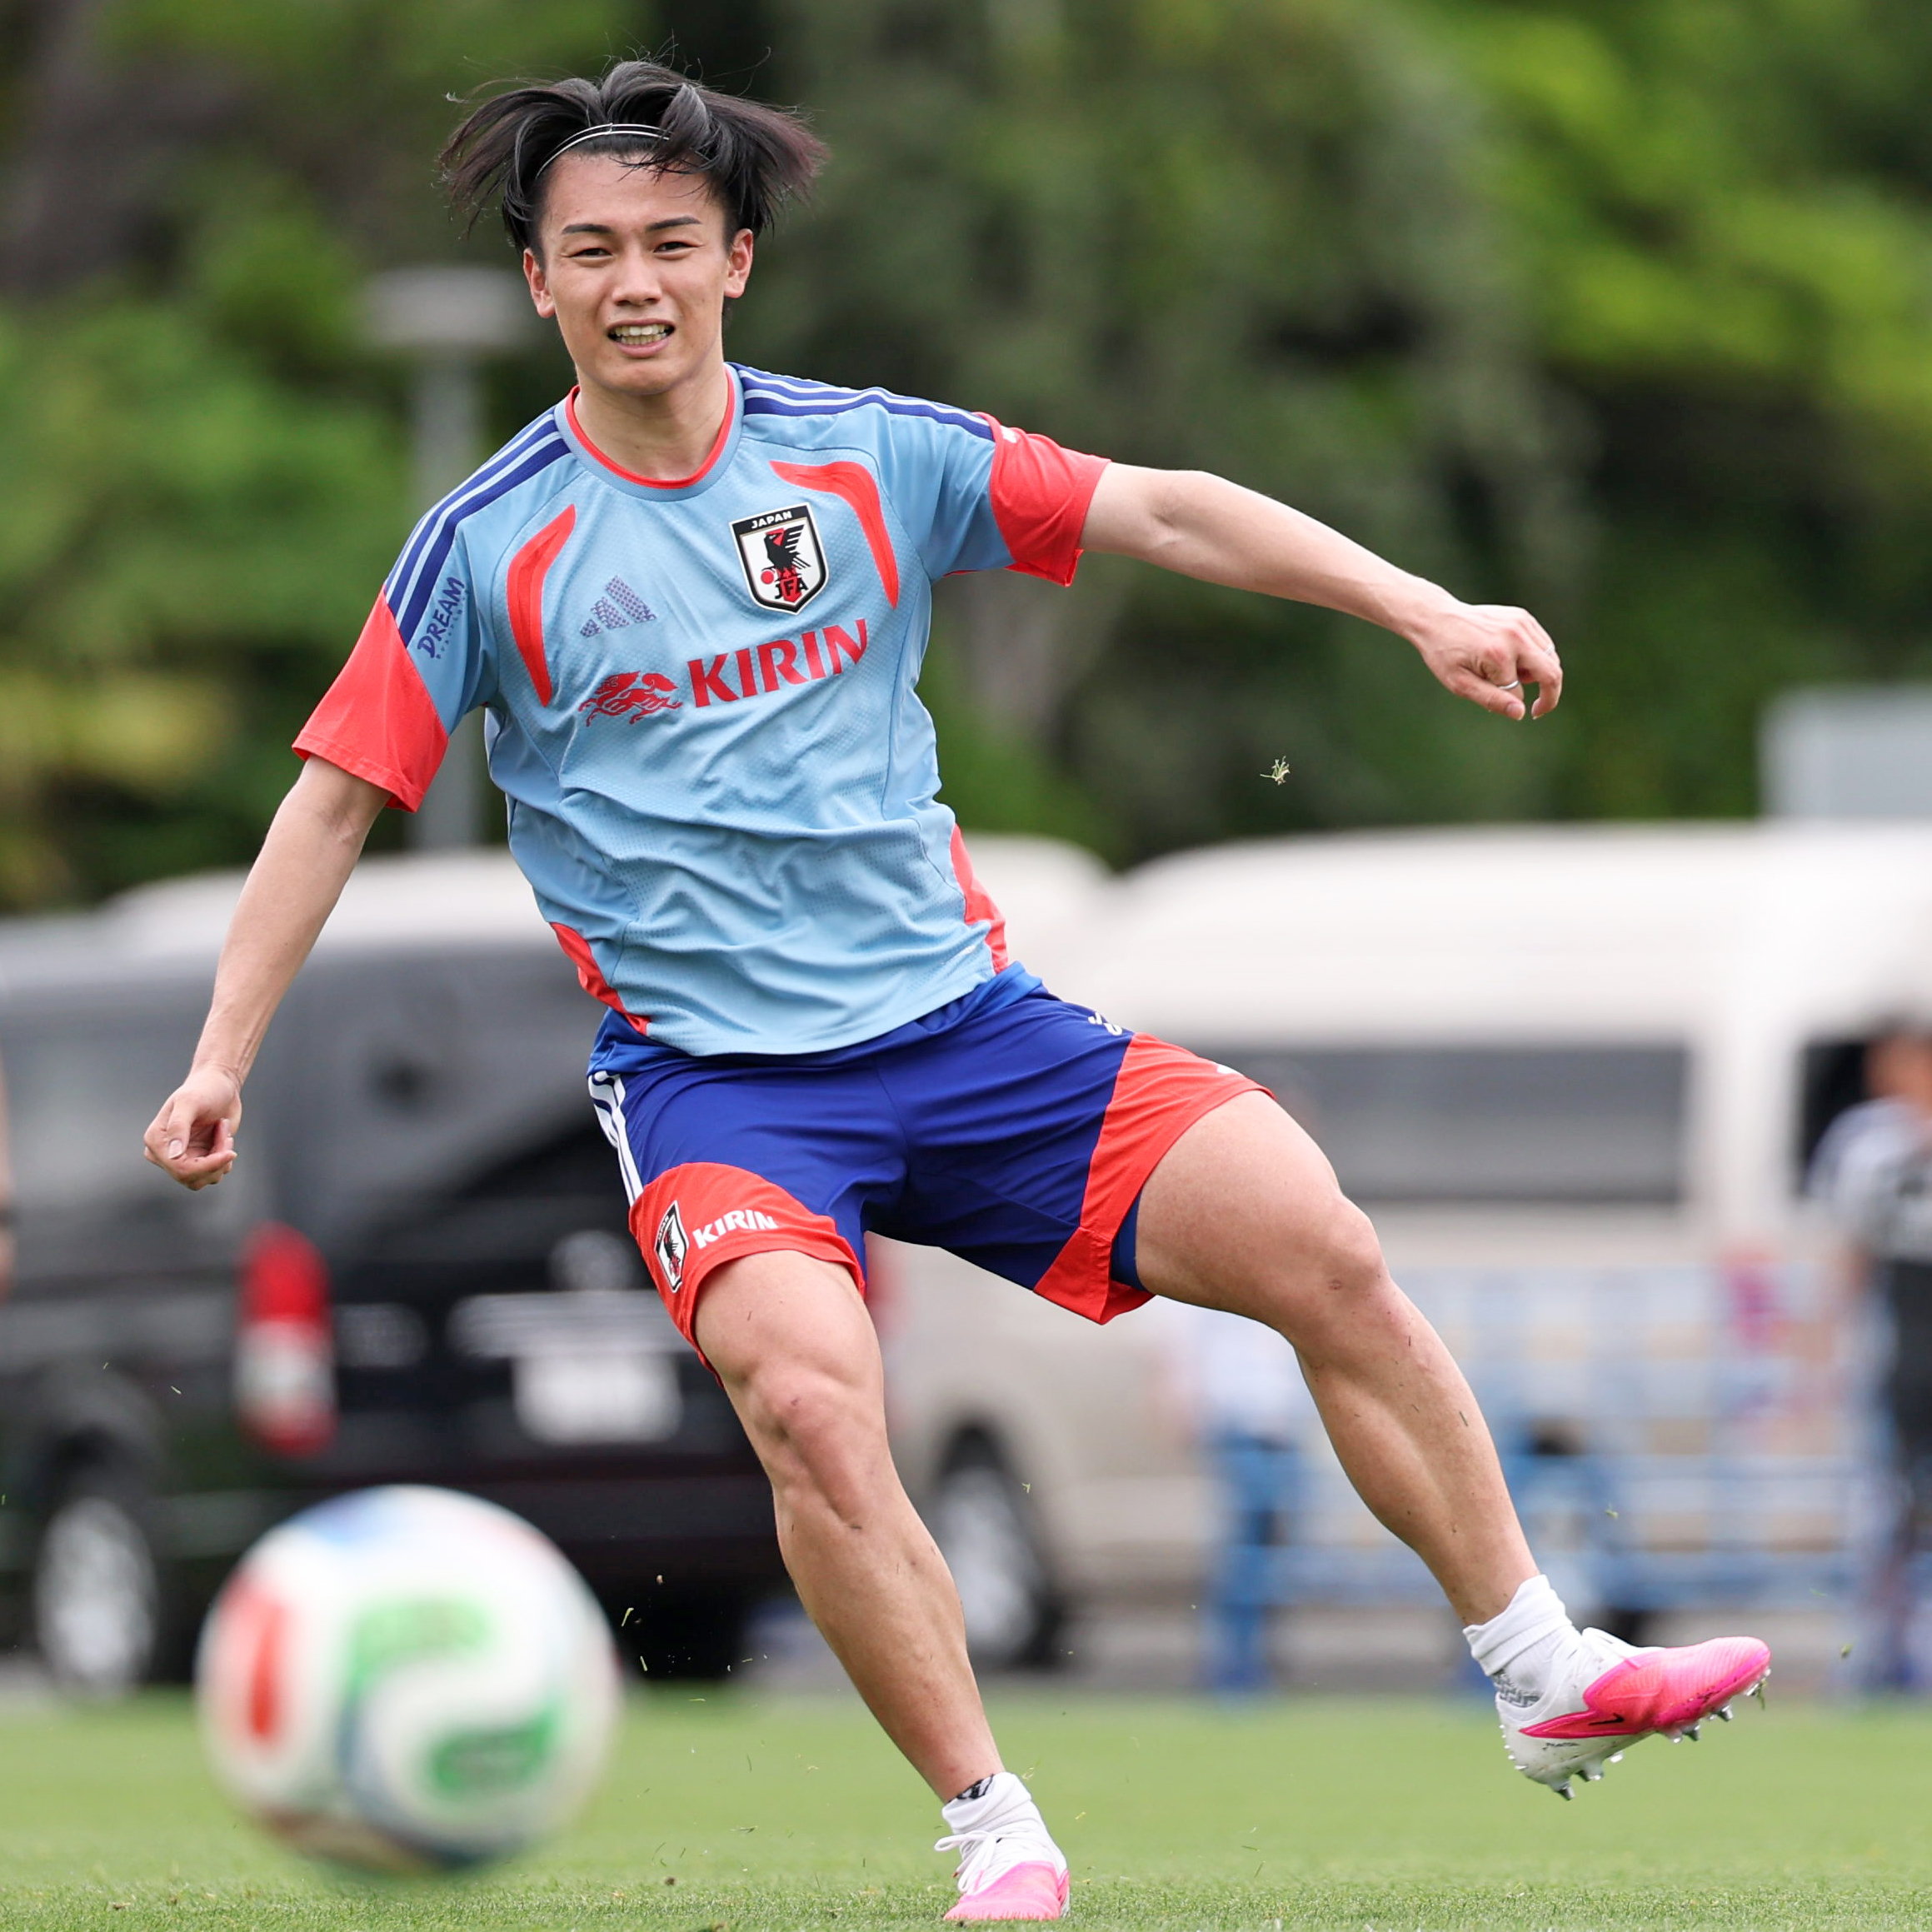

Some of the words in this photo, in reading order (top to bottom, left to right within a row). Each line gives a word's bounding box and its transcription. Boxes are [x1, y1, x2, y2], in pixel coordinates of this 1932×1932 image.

[751, 511, 792, 529] JAPAN
[417, 577, 465, 658] DREAM
[687, 618, 867, 707] KIRIN
[692, 1209, 779, 1250] KIRIN
